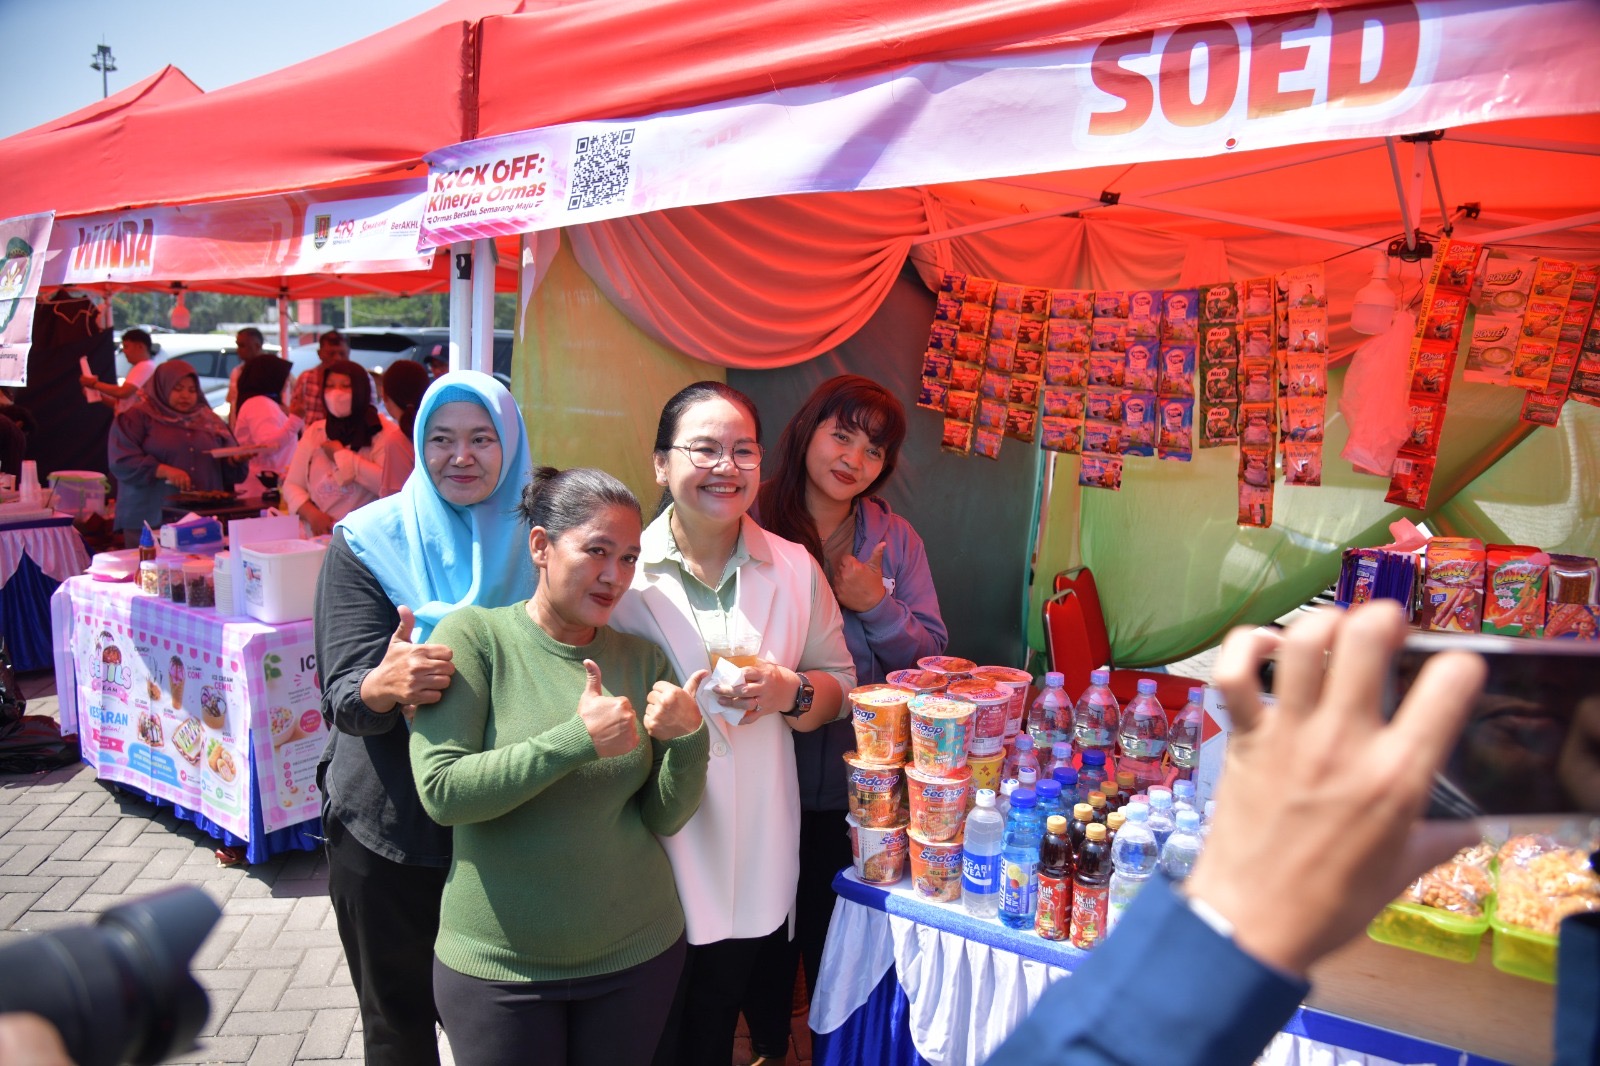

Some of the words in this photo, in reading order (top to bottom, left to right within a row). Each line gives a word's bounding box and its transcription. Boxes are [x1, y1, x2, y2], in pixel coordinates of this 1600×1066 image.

[1088, 1, 1420, 136] SOED
[434, 163, 490, 192] KICK
[492, 153, 545, 184] OFF:
[427, 188, 481, 213] Kinerja
[487, 181, 546, 202] Ormas
[432, 214, 453, 224] Ormas
[479, 204, 514, 216] Semarang
[515, 201, 534, 212] Maju
[391, 220, 419, 230] BerAKHL
[74, 218, 154, 270] WINDA
[300, 654, 316, 673] IC
[853, 706, 876, 721] daap
[912, 720, 943, 734] edaap
[851, 773, 899, 787] Sedaap
[922, 787, 965, 798] Sedaap
[920, 851, 963, 863] Sedaa
[963, 860, 992, 874] OCARI
[963, 867, 987, 878] WEAT
